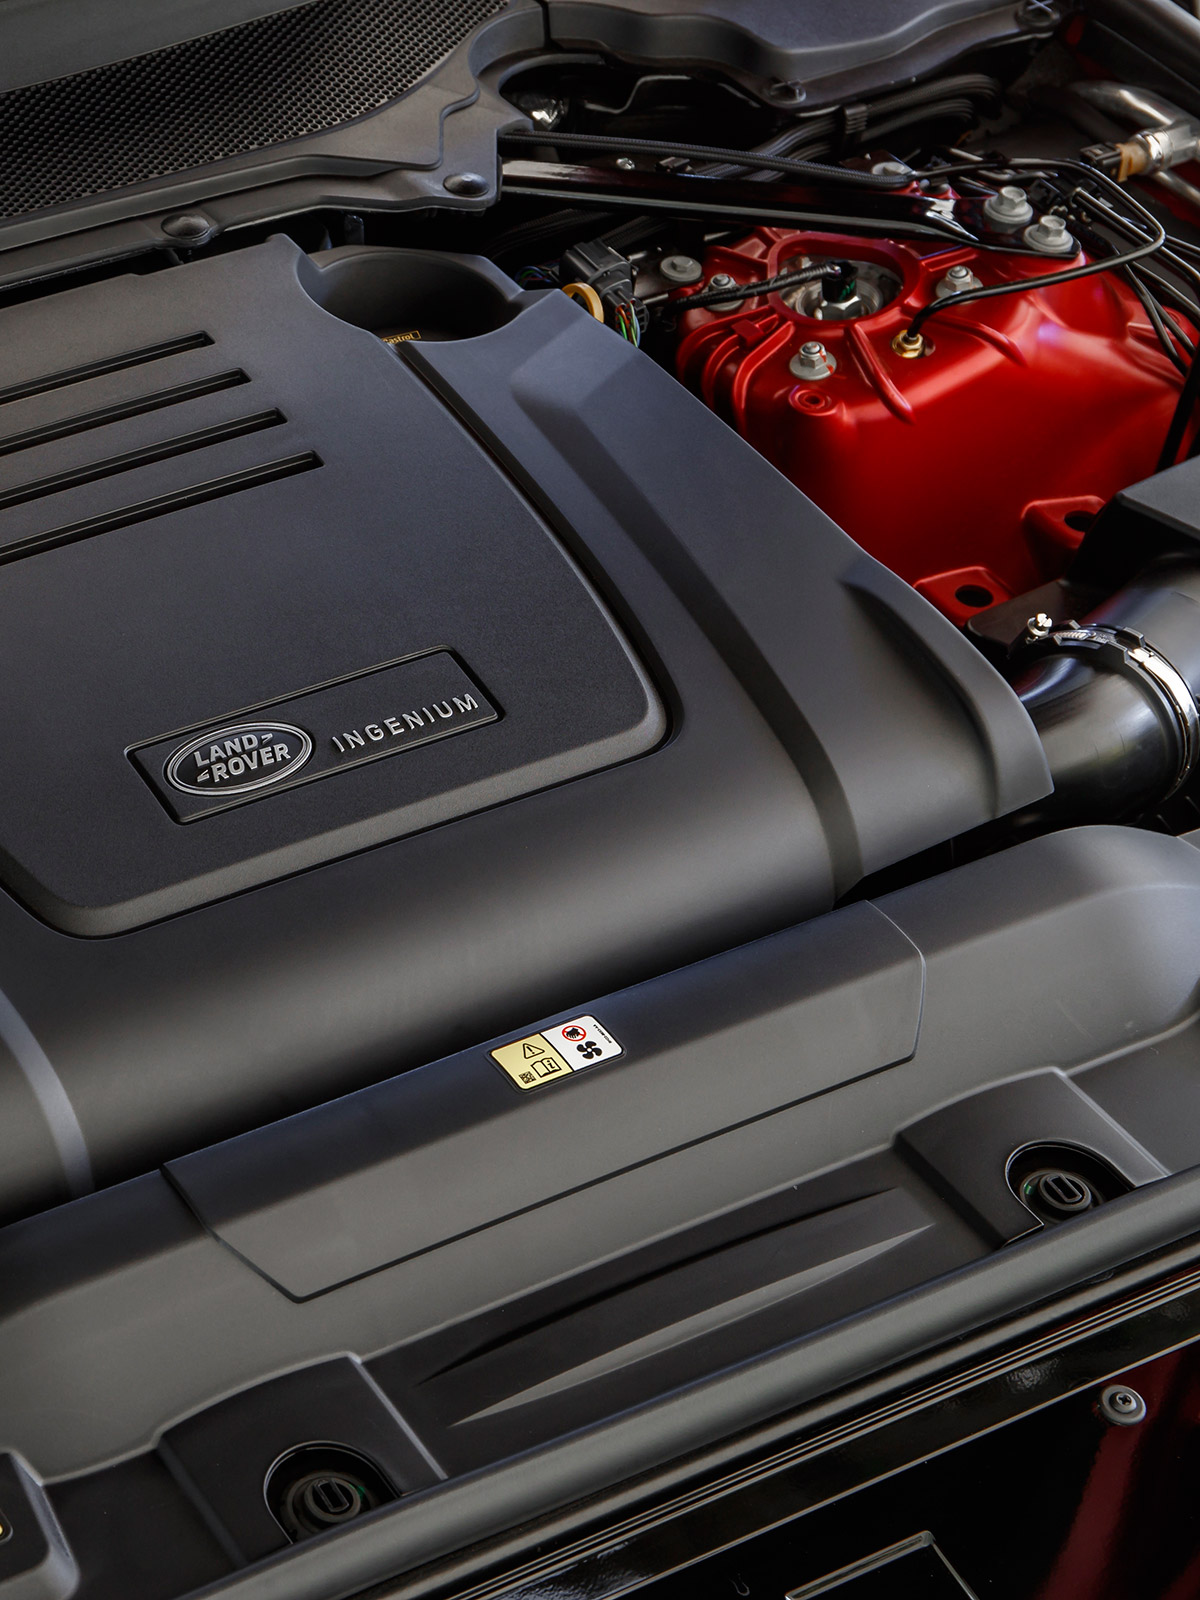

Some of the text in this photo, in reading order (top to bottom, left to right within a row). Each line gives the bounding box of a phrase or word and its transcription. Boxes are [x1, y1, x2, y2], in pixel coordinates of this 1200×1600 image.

[332, 693, 479, 752] INGENIUM
[194, 733, 259, 767] LAND
[213, 743, 291, 782] ROVER
